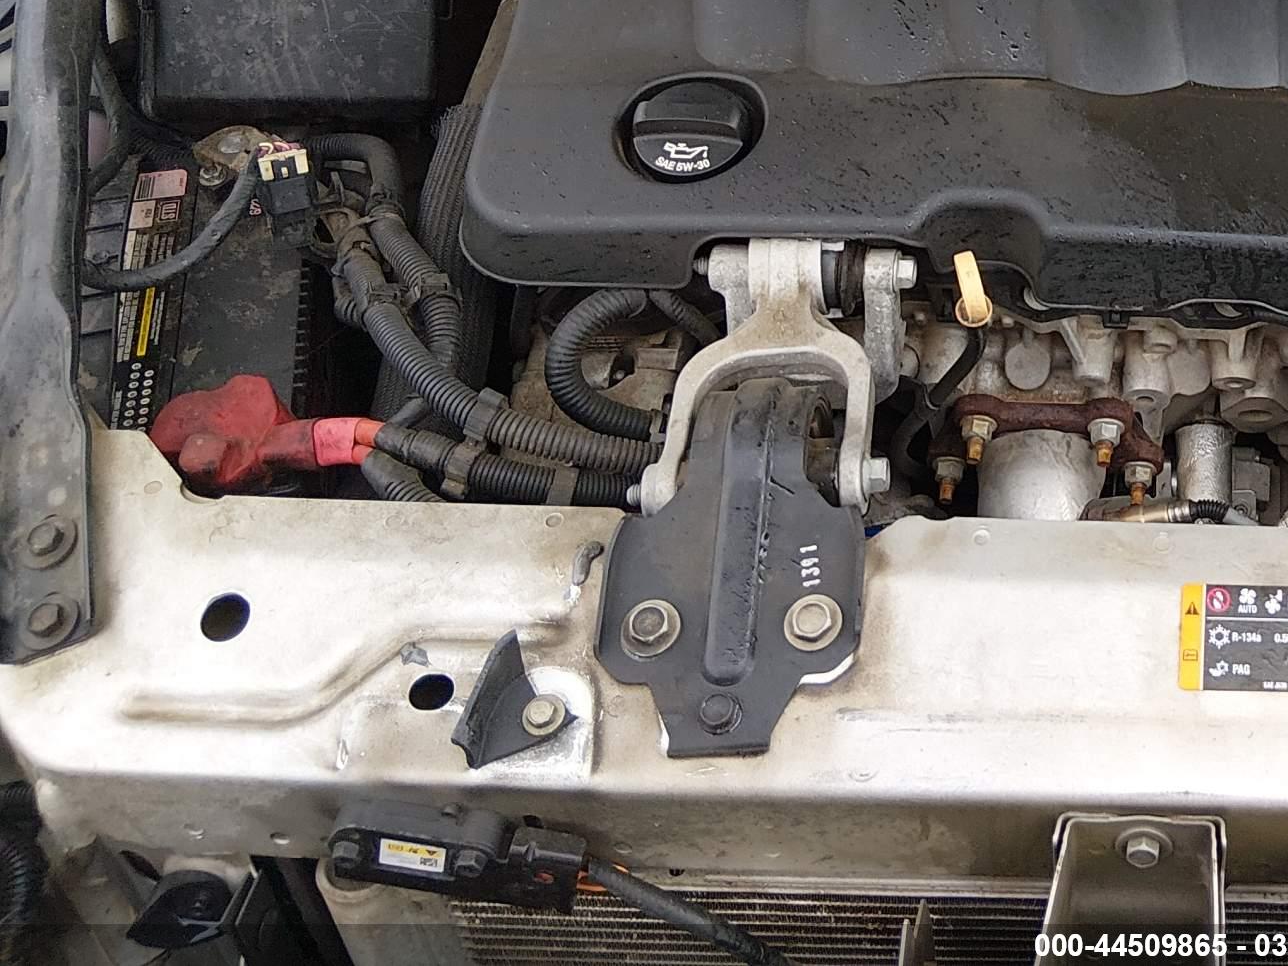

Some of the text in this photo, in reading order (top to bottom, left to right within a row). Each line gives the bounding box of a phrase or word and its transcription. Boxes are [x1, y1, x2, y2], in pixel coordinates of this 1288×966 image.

[655, 156, 711, 172] SAE 5W-30
[798, 544, 822, 589] 1391
[1237, 604, 1258, 614] AUTO
[1231, 631, 1262, 643] R-134a
[1231, 663, 1251, 675] PAG
